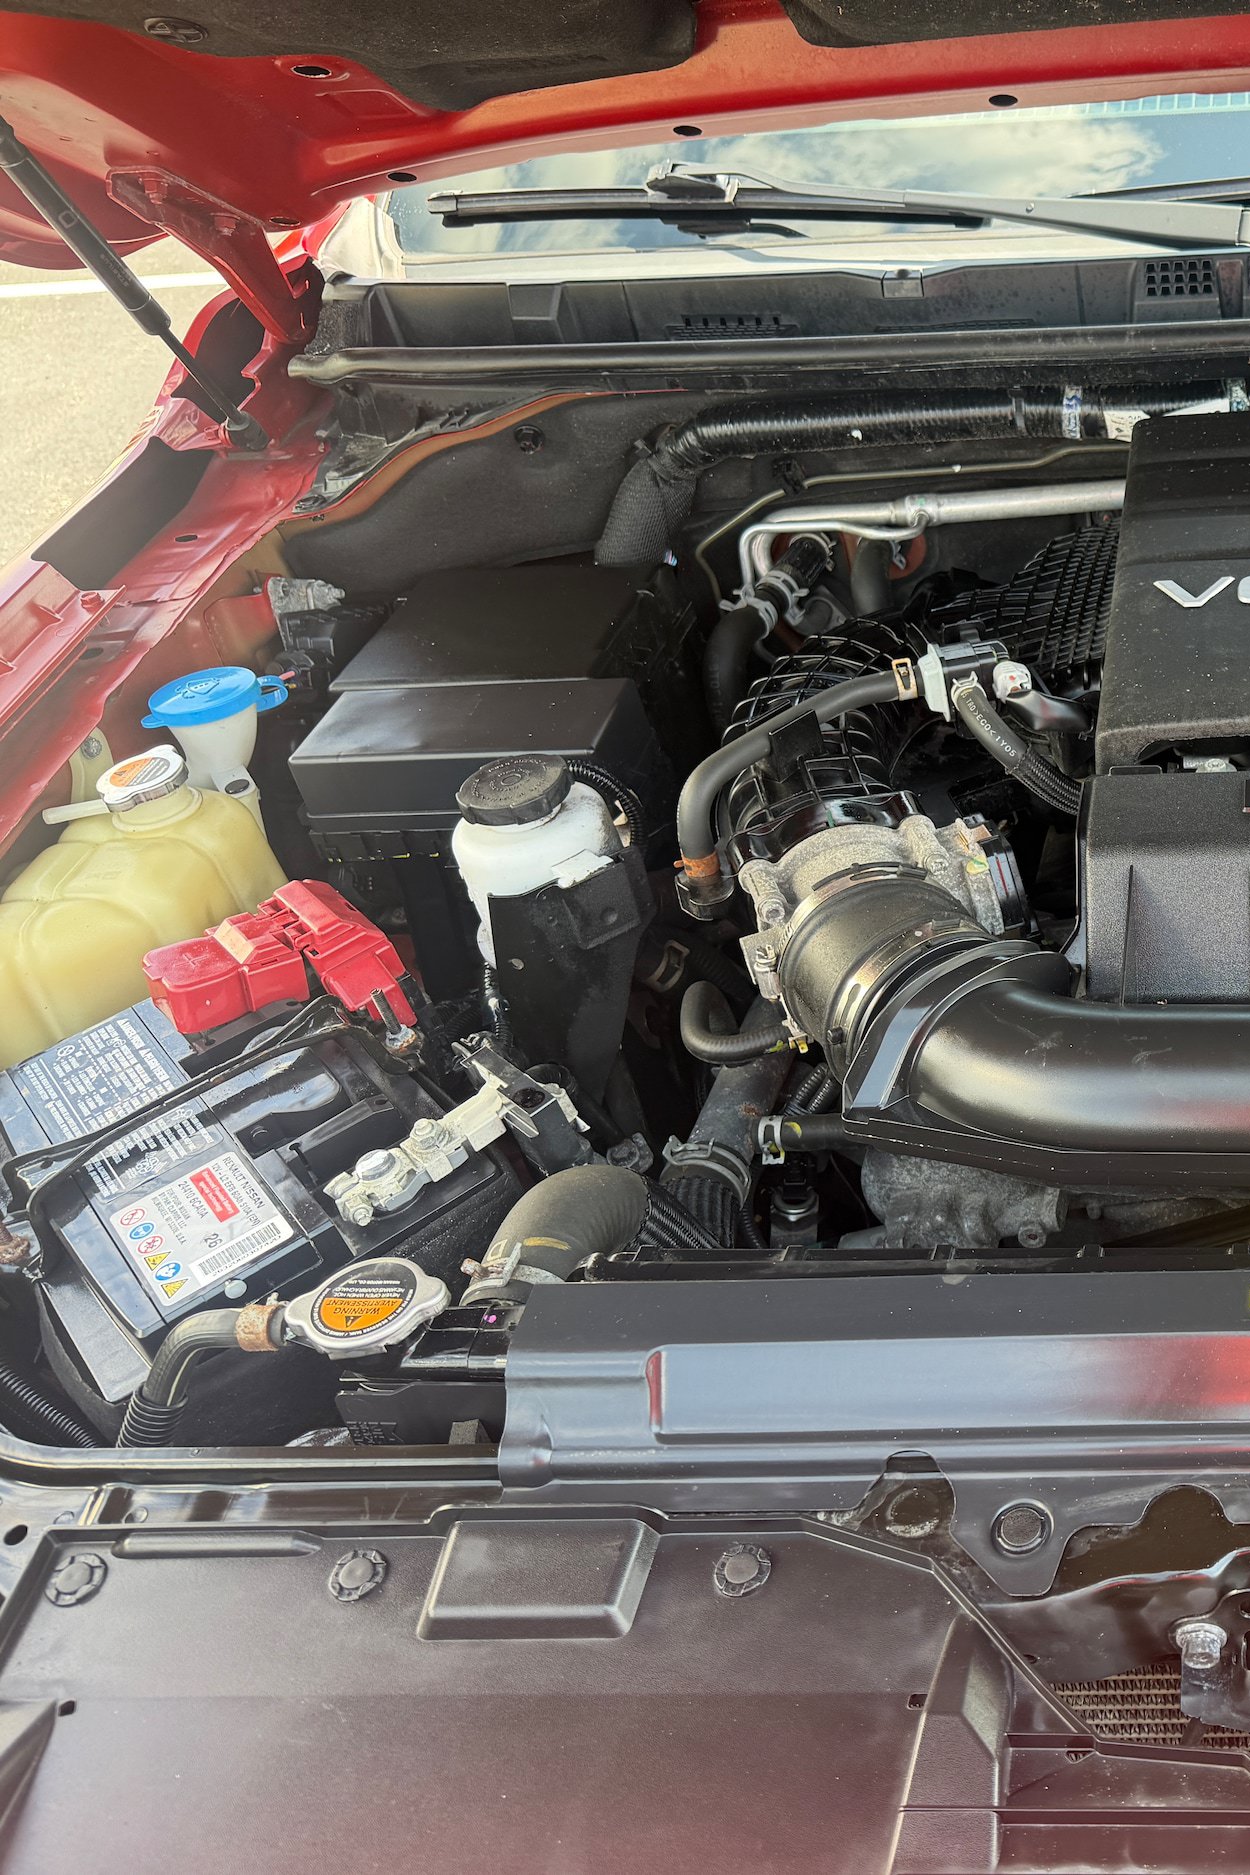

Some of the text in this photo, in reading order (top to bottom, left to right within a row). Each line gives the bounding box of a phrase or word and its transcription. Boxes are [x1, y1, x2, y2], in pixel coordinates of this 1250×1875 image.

[210, 1163, 221, 1172] 12V
[222, 1155, 264, 1209] RENAULT NISSAN
[202, 1232, 223, 1248] 26
